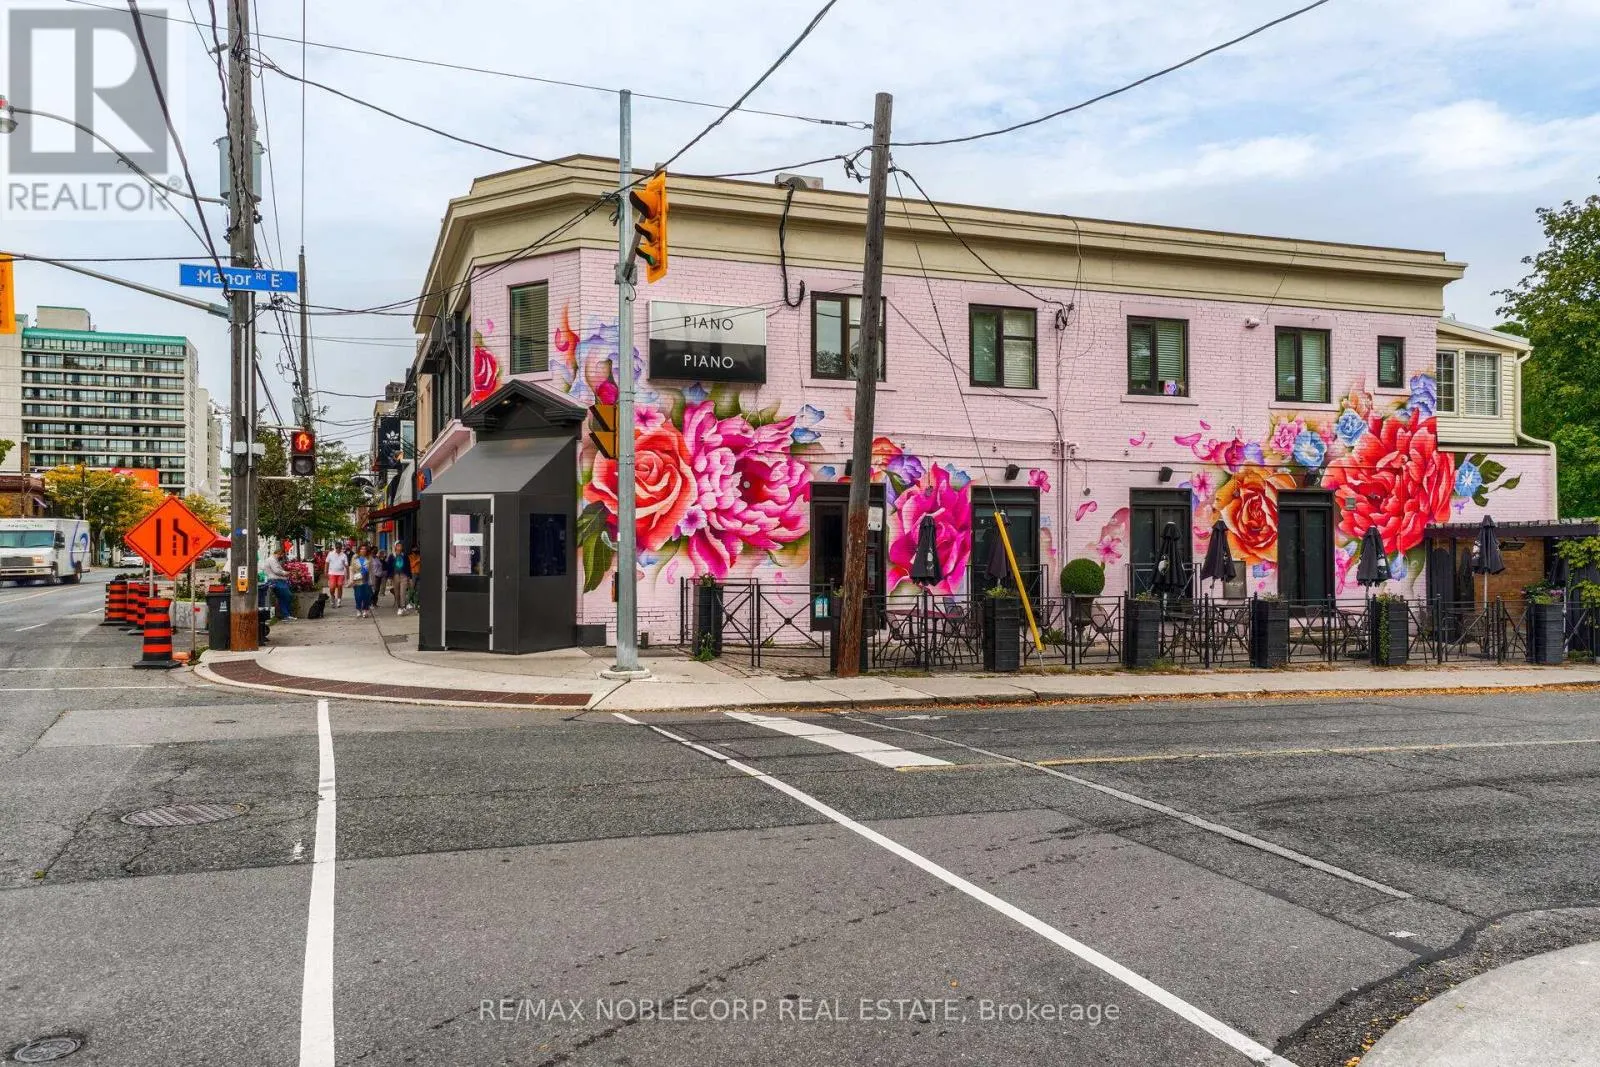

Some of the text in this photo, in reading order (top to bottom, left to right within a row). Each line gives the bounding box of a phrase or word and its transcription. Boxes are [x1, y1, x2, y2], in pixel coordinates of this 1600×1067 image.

[198, 269, 280, 288] Manor Rd E
[684, 315, 734, 331] PIANO
[684, 354, 734, 369] PIANO
